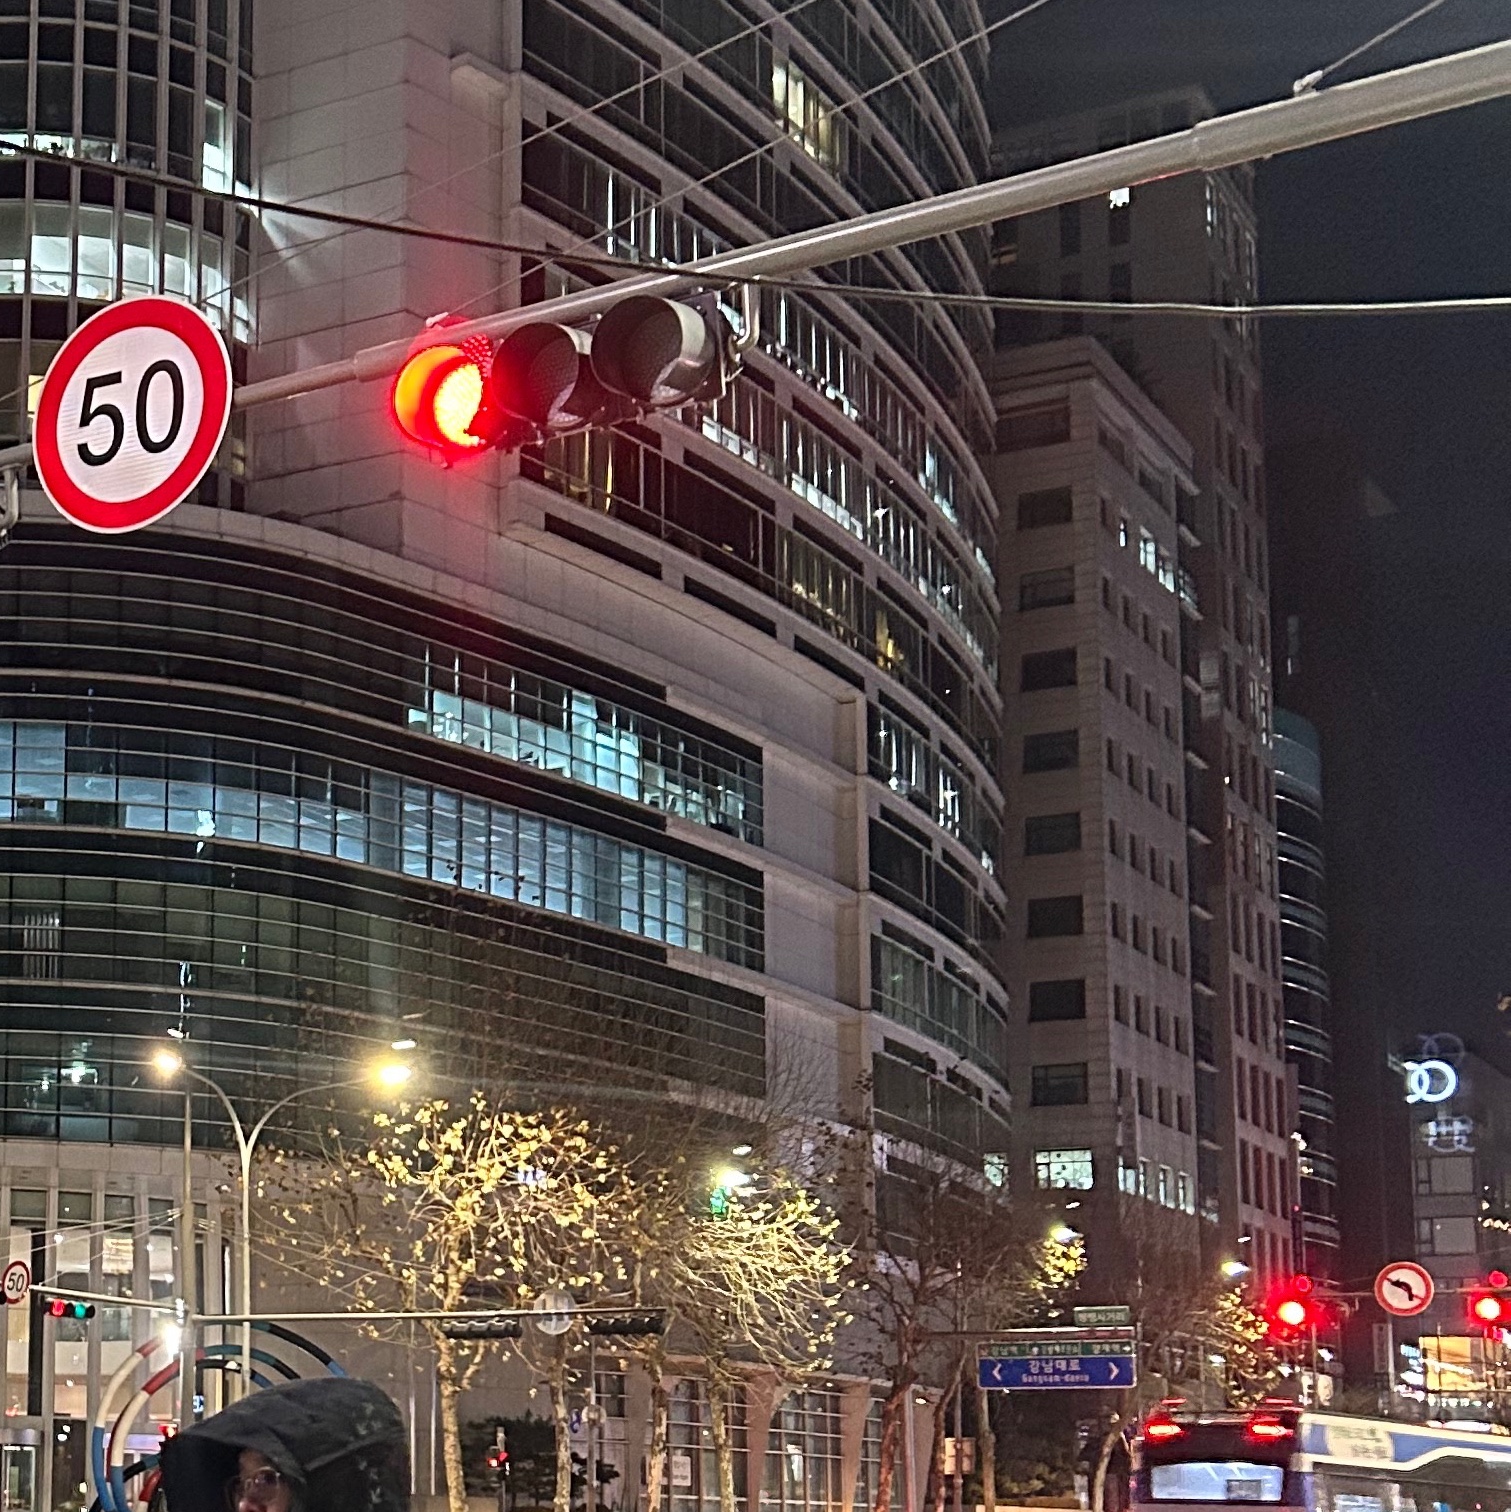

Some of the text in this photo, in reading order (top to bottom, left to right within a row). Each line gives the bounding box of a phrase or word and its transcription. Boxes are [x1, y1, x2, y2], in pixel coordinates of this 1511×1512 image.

[77, 359, 185, 467] 50
[7, 1271, 25, 1293] 50
[1028, 1359, 1081, 1374] 강남대로
